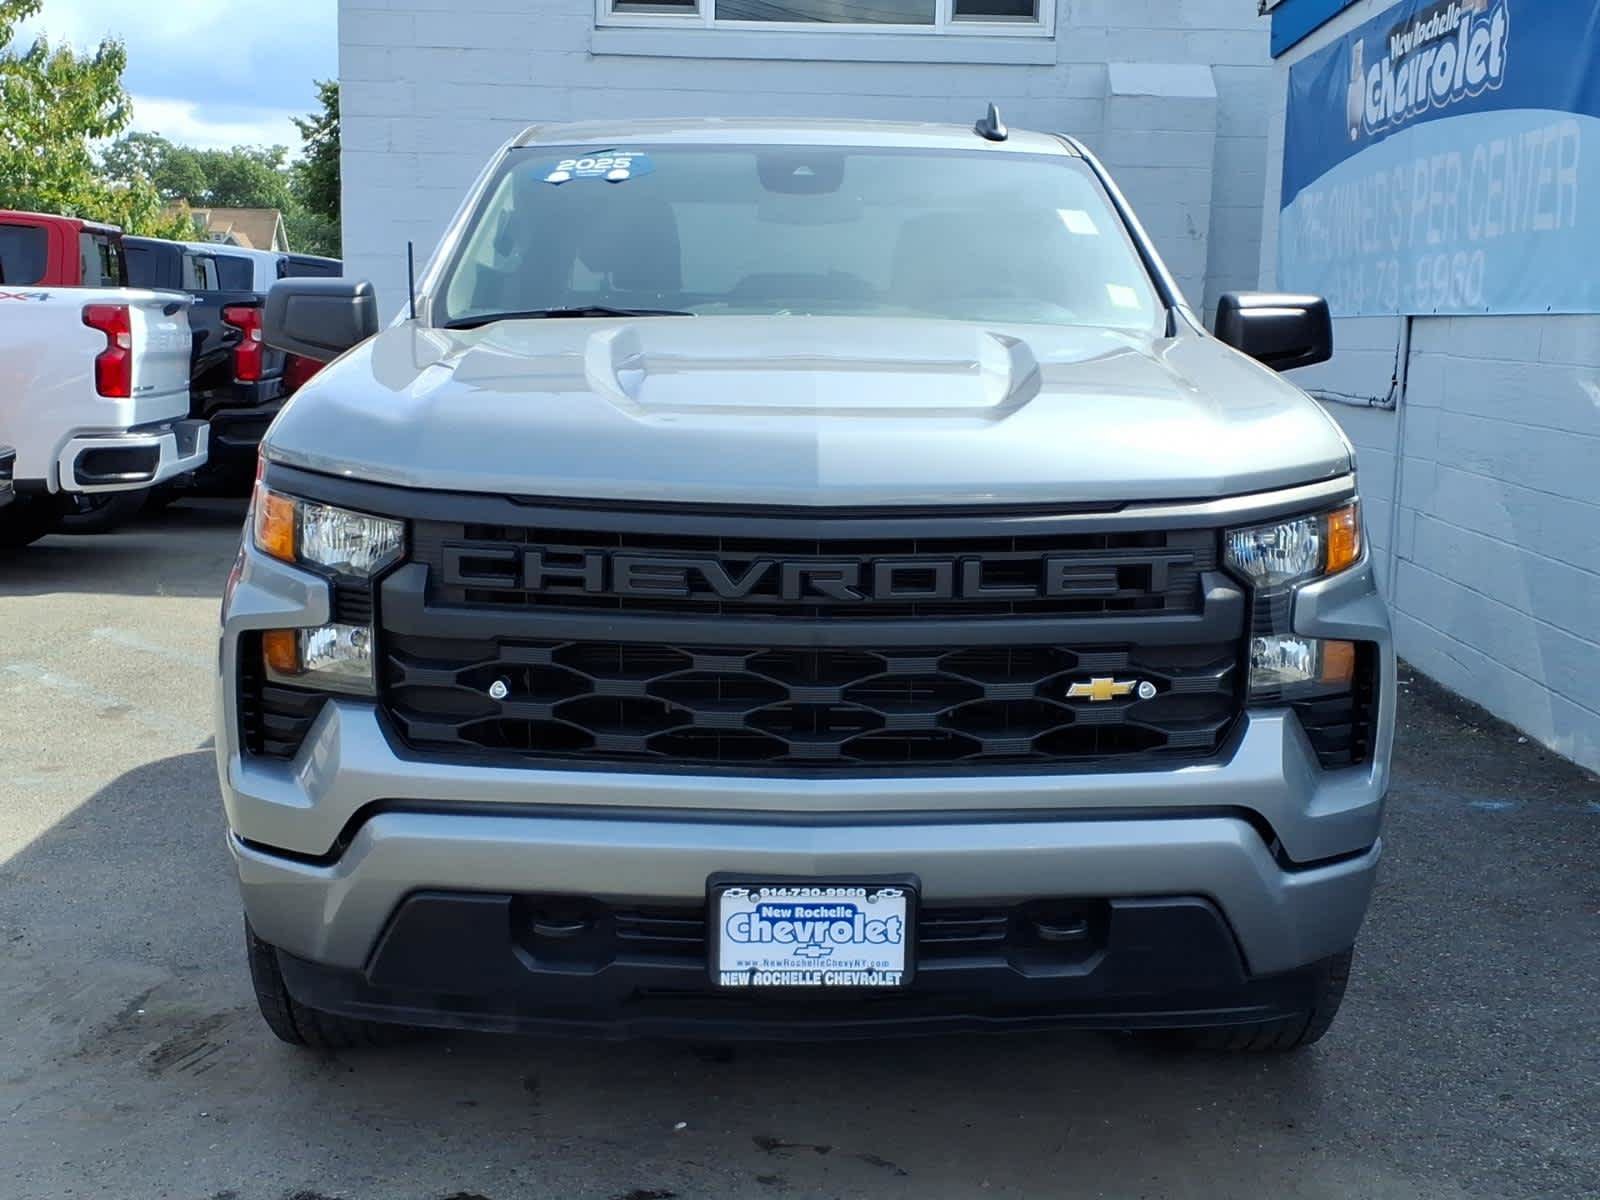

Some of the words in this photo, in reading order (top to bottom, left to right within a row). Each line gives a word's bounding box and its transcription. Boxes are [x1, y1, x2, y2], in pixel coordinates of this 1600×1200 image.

[1390, 31, 1414, 60] New
[1366, 5, 1506, 125] Chevrolet
[555, 157, 632, 171] 2025
[1467, 118, 1582, 241] CENTER
[441, 543, 1196, 601] CHEVROLET
[761, 906, 792, 918] New
[794, 905, 854, 918] Rochelle
[726, 912, 903, 944] Chevrolet
[720, 971, 749, 986] NEW
[753, 970, 821, 986] ROCHELLE
[825, 970, 903, 986] CHEVROLET
